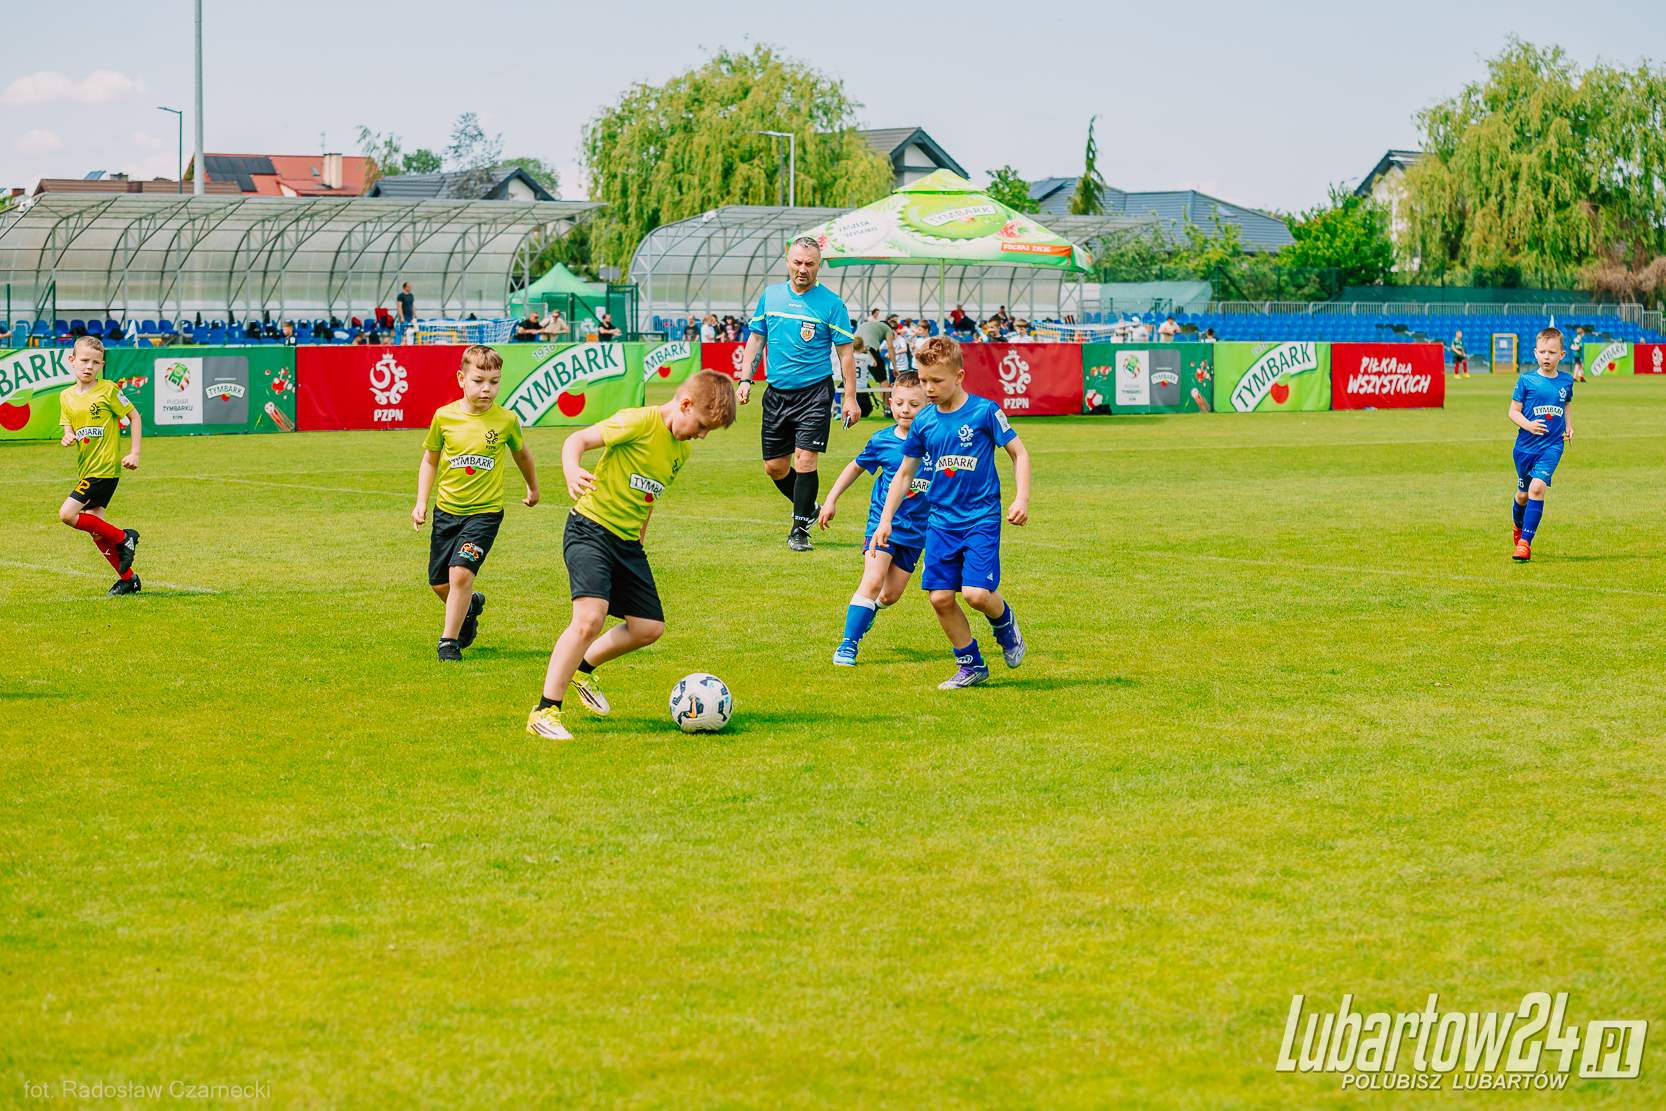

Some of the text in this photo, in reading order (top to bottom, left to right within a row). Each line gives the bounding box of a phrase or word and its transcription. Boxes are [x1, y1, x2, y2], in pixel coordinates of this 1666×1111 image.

[1360, 356, 1396, 373] PIŁKA
[511, 342, 619, 423] TYMBARK
[1236, 341, 1310, 409] TYMBARK
[1347, 373, 1430, 394] WSZYSTKICH
[208, 384, 243, 397] TYMBARK
[1003, 397, 1030, 409] PZPN
[373, 408, 403, 422] PZPN
